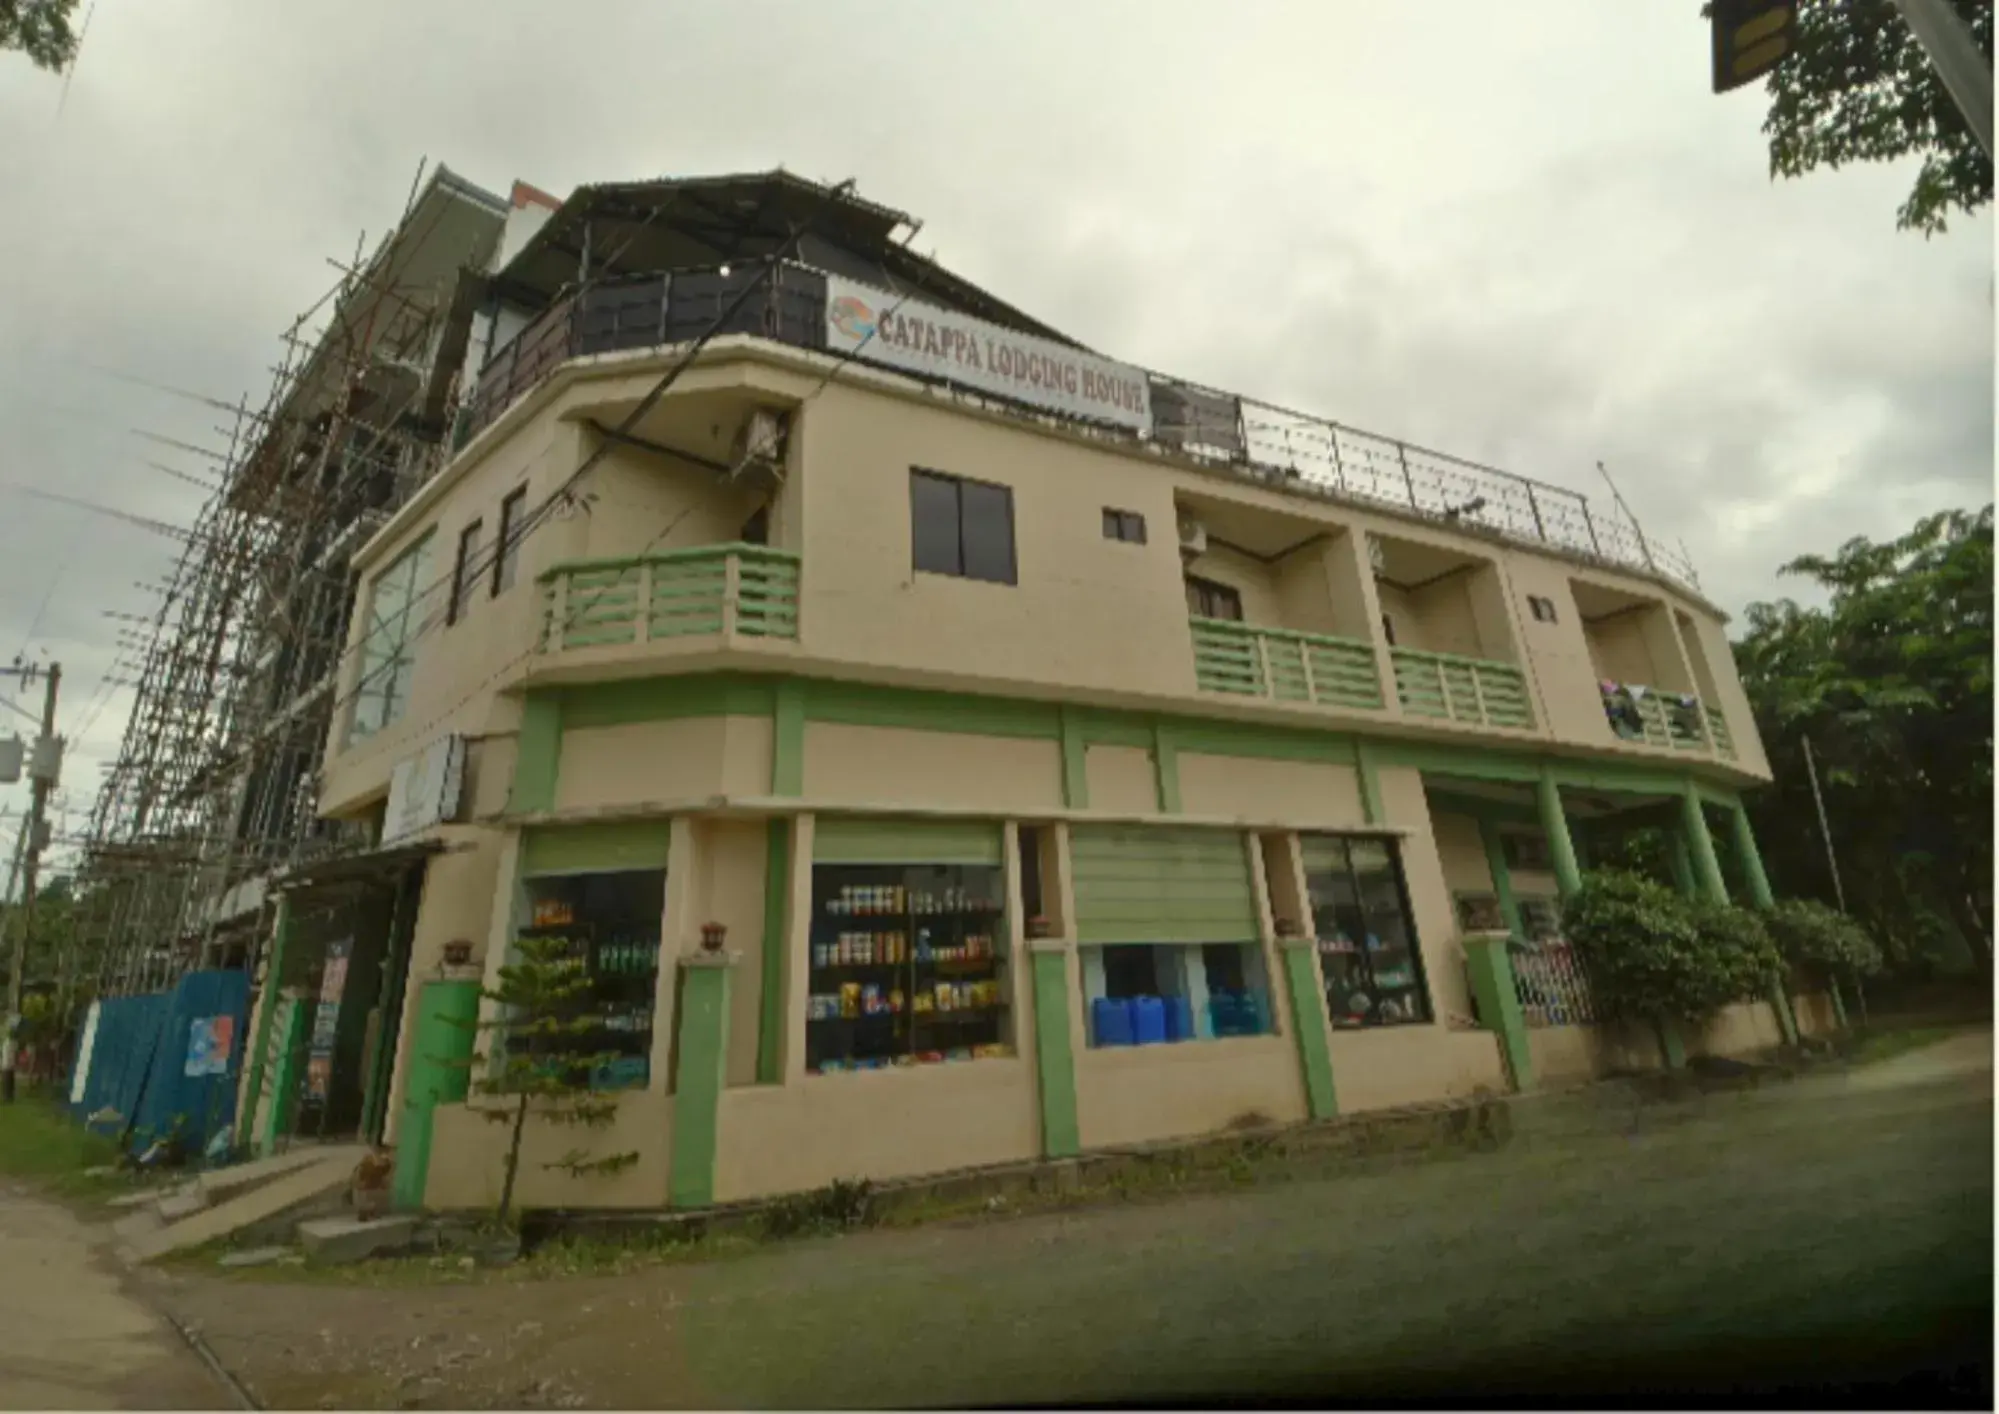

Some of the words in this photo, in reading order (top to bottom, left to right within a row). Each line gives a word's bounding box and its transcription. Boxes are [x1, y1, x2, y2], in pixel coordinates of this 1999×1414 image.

[878, 309, 982, 367] CATAPPA
[987, 342, 1077, 394] LODGING
[1082, 369, 1144, 414] HOUSE
